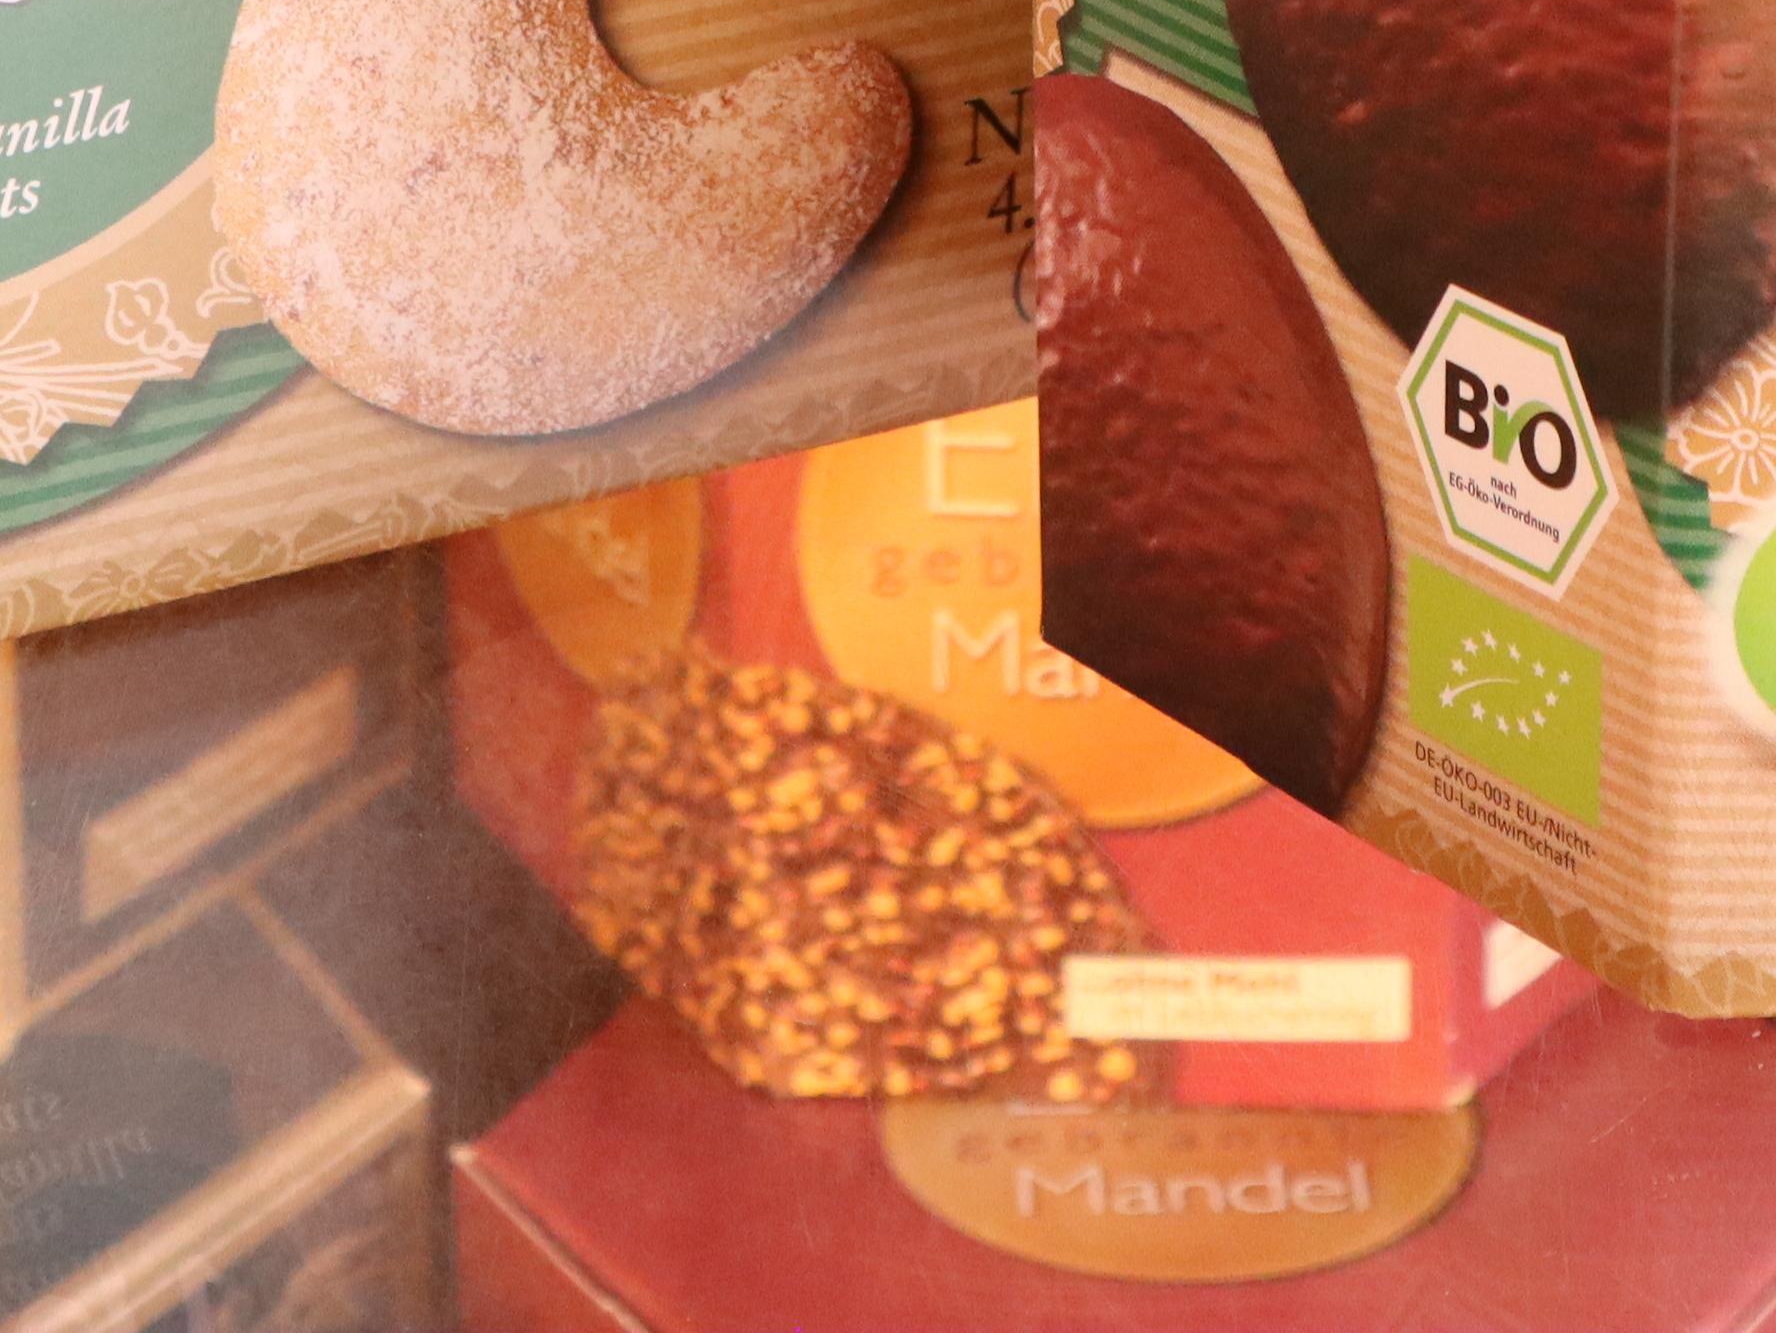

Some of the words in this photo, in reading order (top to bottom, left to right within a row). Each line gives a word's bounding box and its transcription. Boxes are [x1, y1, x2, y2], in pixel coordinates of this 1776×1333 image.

[1447, 468, 1561, 544] EG-Öko-Verordnung
[1489, 473, 1518, 501] nach
[1413, 738, 1514, 815] DE-ÖKO-003
[1513, 795, 1598, 858] EU-/Nicht-
[1432, 770, 1581, 878] EU-Landwirtschaft
[1010, 1159, 1373, 1218] Mandel
